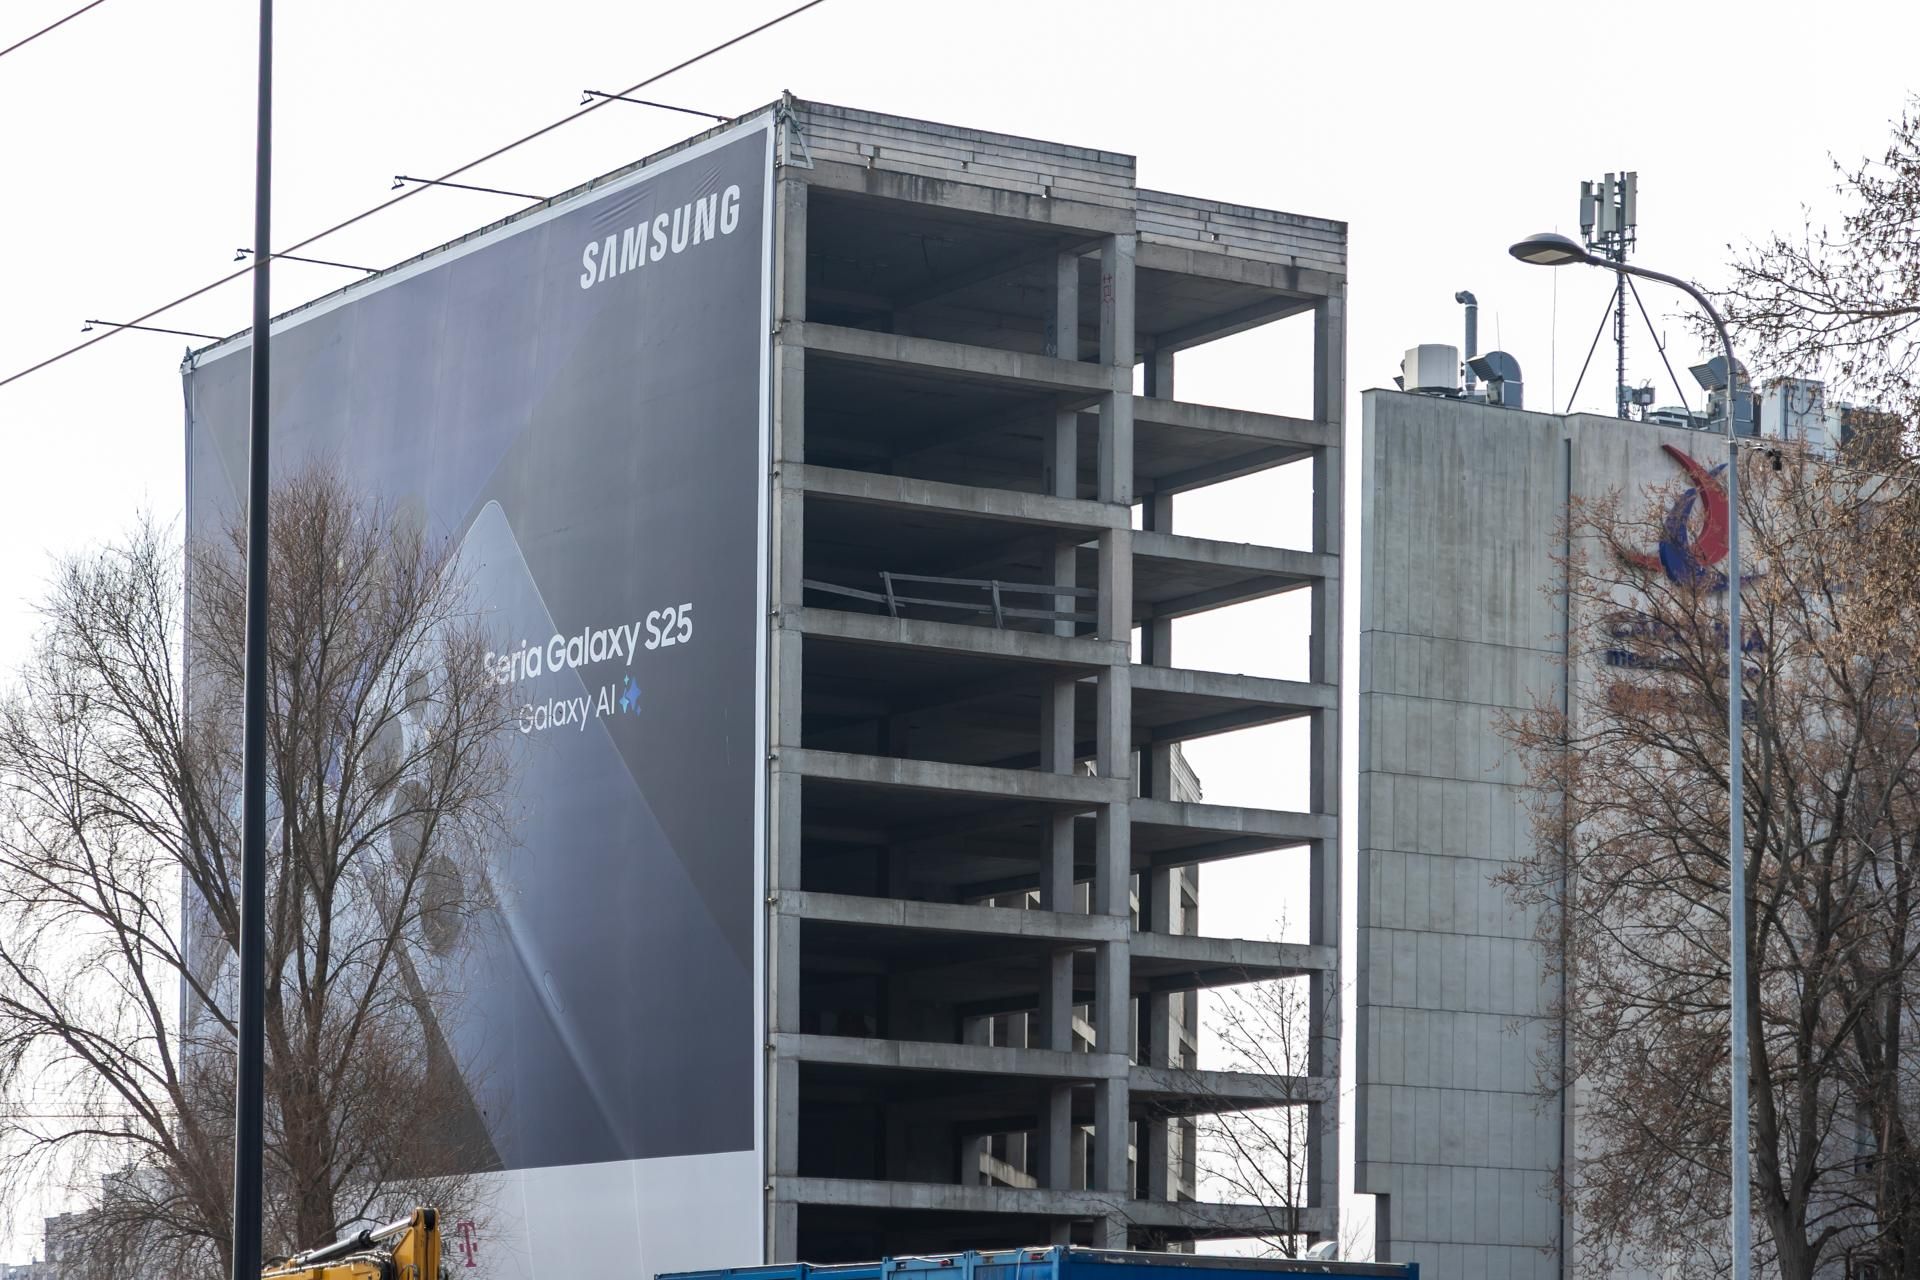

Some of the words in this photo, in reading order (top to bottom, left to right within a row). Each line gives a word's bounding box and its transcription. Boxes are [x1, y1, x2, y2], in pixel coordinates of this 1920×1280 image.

[580, 184, 741, 290] SAMSUNG
[483, 639, 542, 687] Seria
[546, 622, 641, 673] Galaxy
[644, 603, 693, 650] S25
[519, 695, 592, 734] Galaxy
[595, 683, 616, 718] AI
